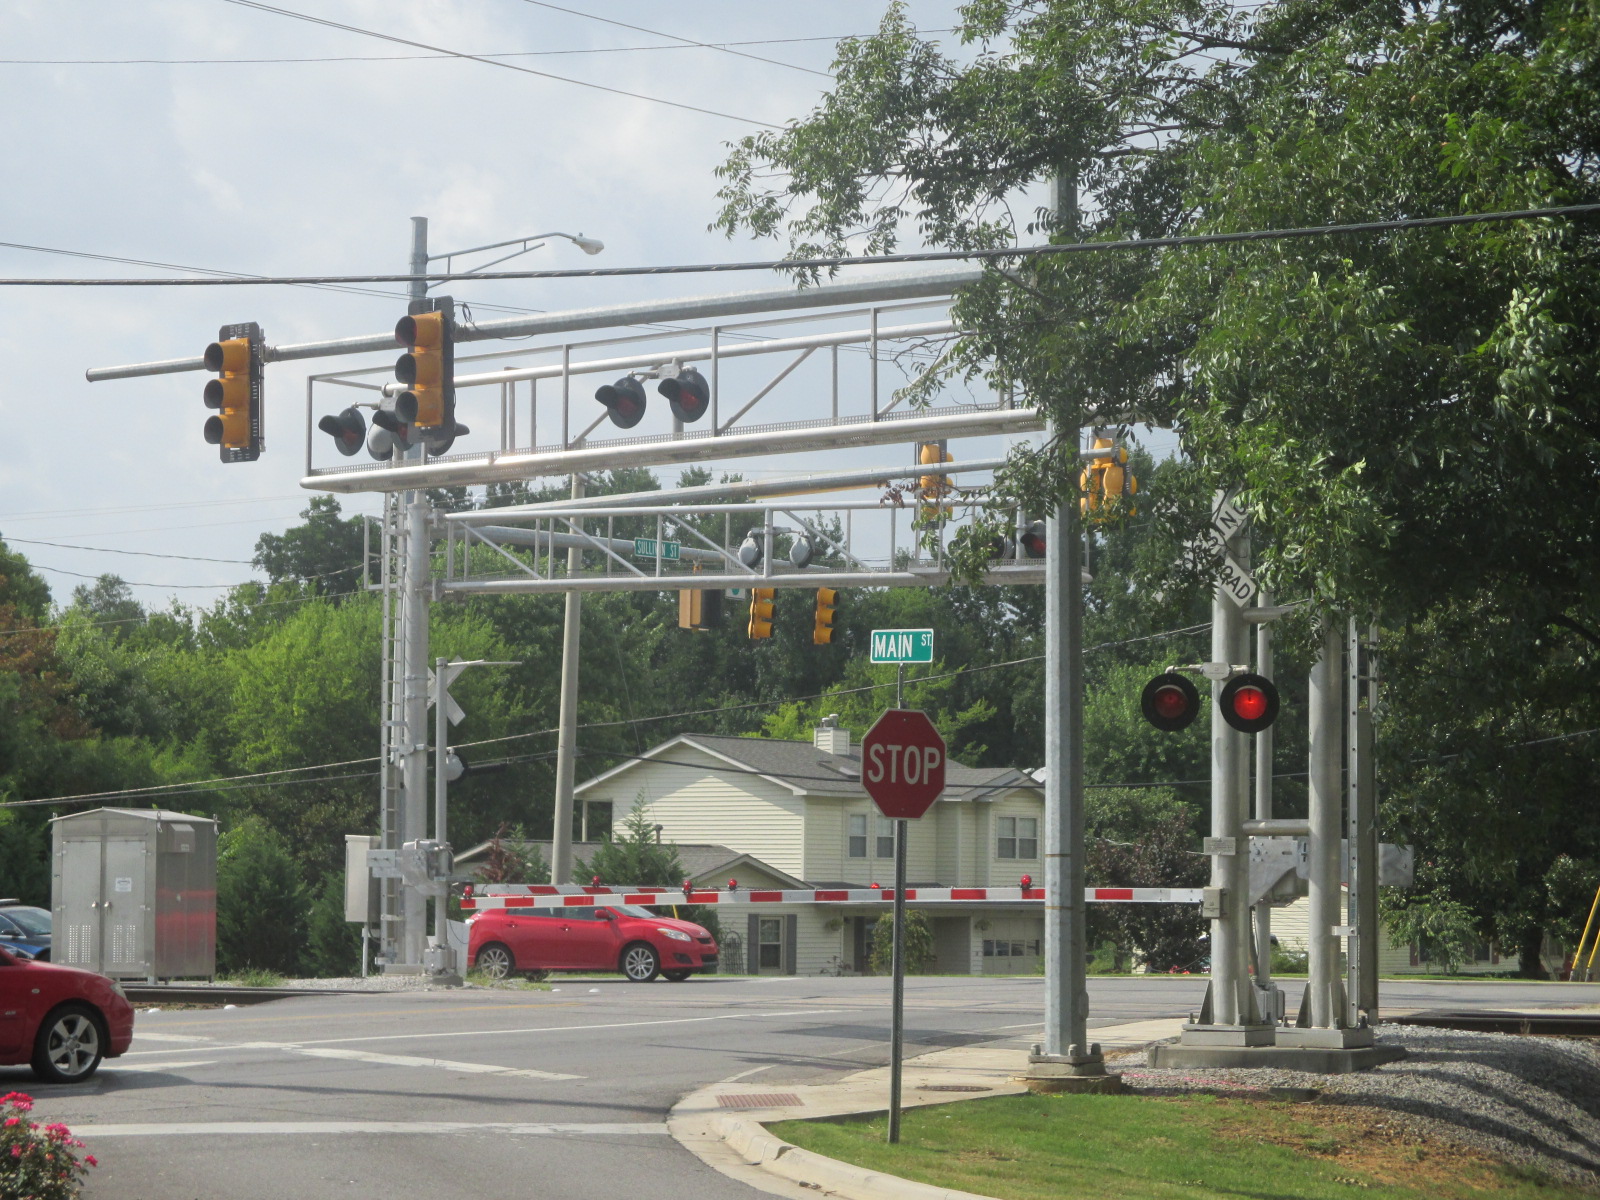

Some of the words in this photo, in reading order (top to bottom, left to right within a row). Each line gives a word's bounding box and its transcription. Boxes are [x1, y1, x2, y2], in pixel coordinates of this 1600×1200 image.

[637, 540, 666, 557] SULLIVN
[670, 544, 678, 558] ST
[1217, 563, 1251, 600] OAD
[874, 634, 913, 658] MAIN
[867, 743, 941, 785] STOP
